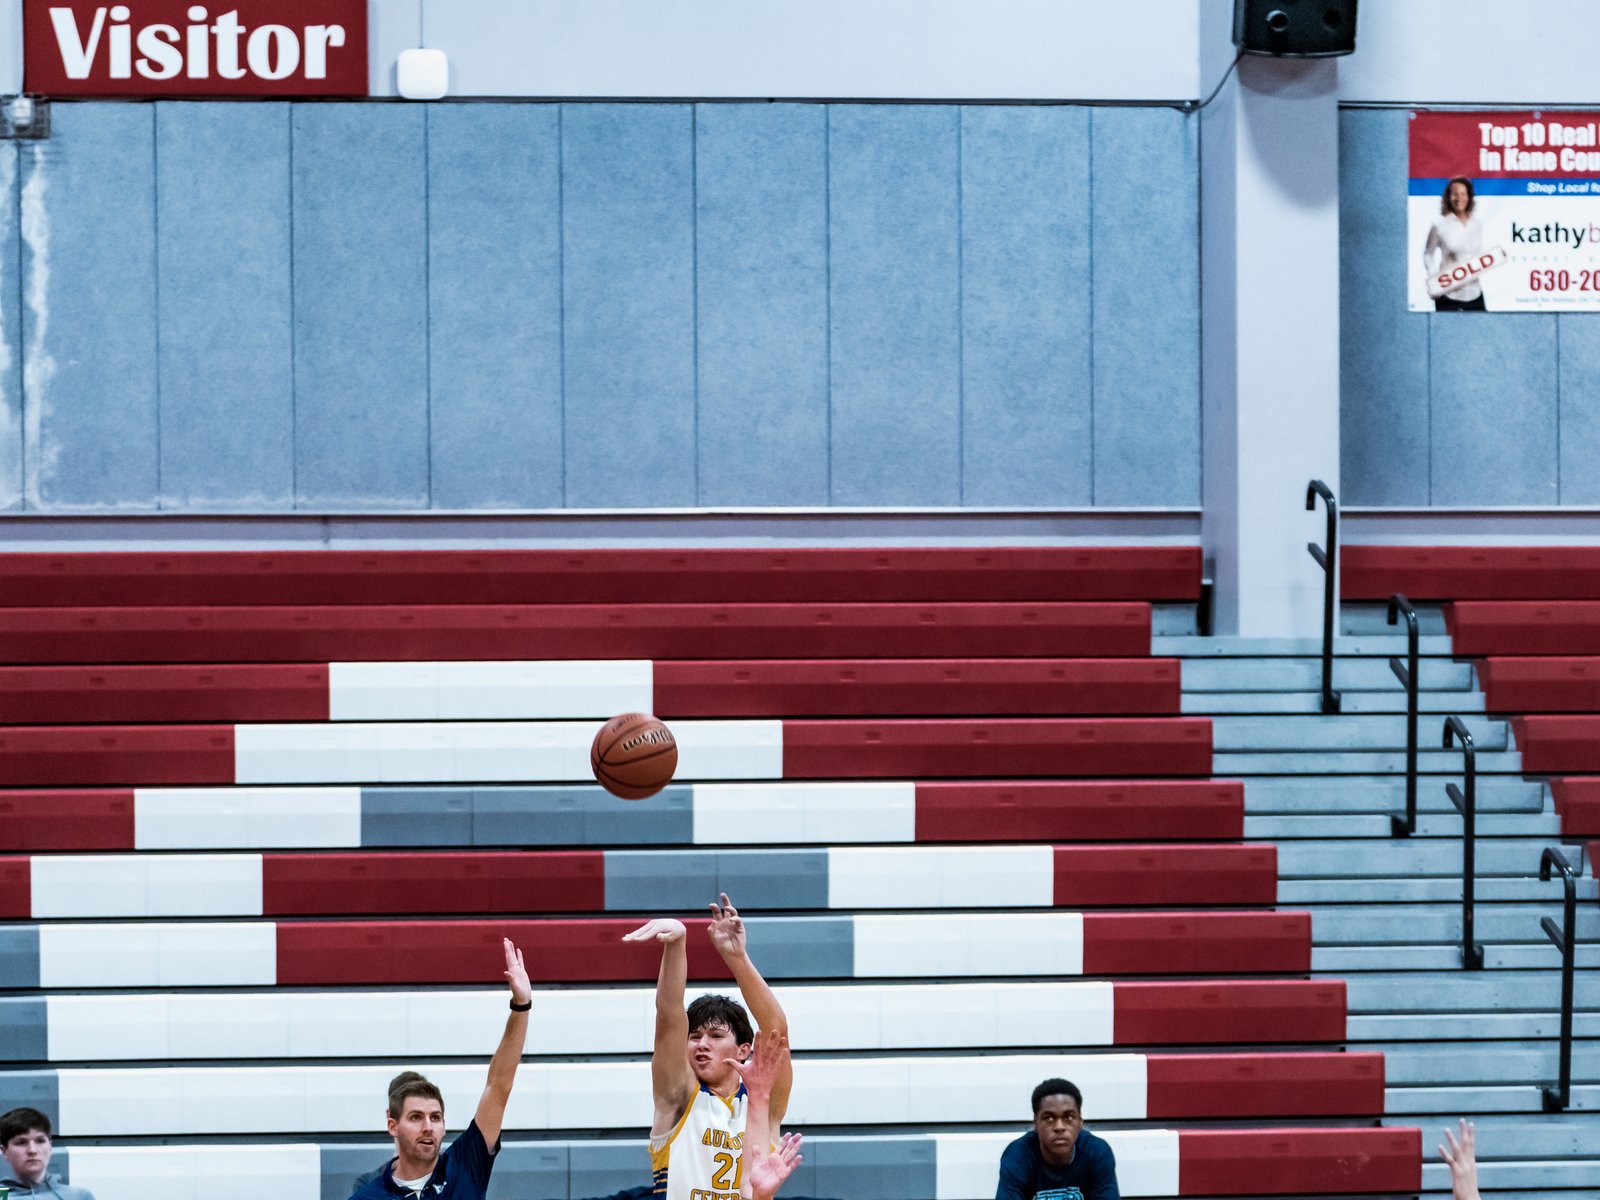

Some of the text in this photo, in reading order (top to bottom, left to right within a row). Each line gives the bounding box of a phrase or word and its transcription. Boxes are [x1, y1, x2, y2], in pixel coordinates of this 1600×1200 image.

[48, 5, 346, 80] Visitor
[1479, 122, 1519, 148] Top
[1521, 122, 1546, 147] 10
[1548, 122, 1596, 147] Real
[1504, 147, 1558, 171] Kane
[1527, 182, 1557, 195] Shop
[1558, 182, 1590, 193] Local
[1438, 254, 1495, 288] SOLD
[701, 1128, 745, 1150] AURO
[711, 1151, 743, 1190] 21
